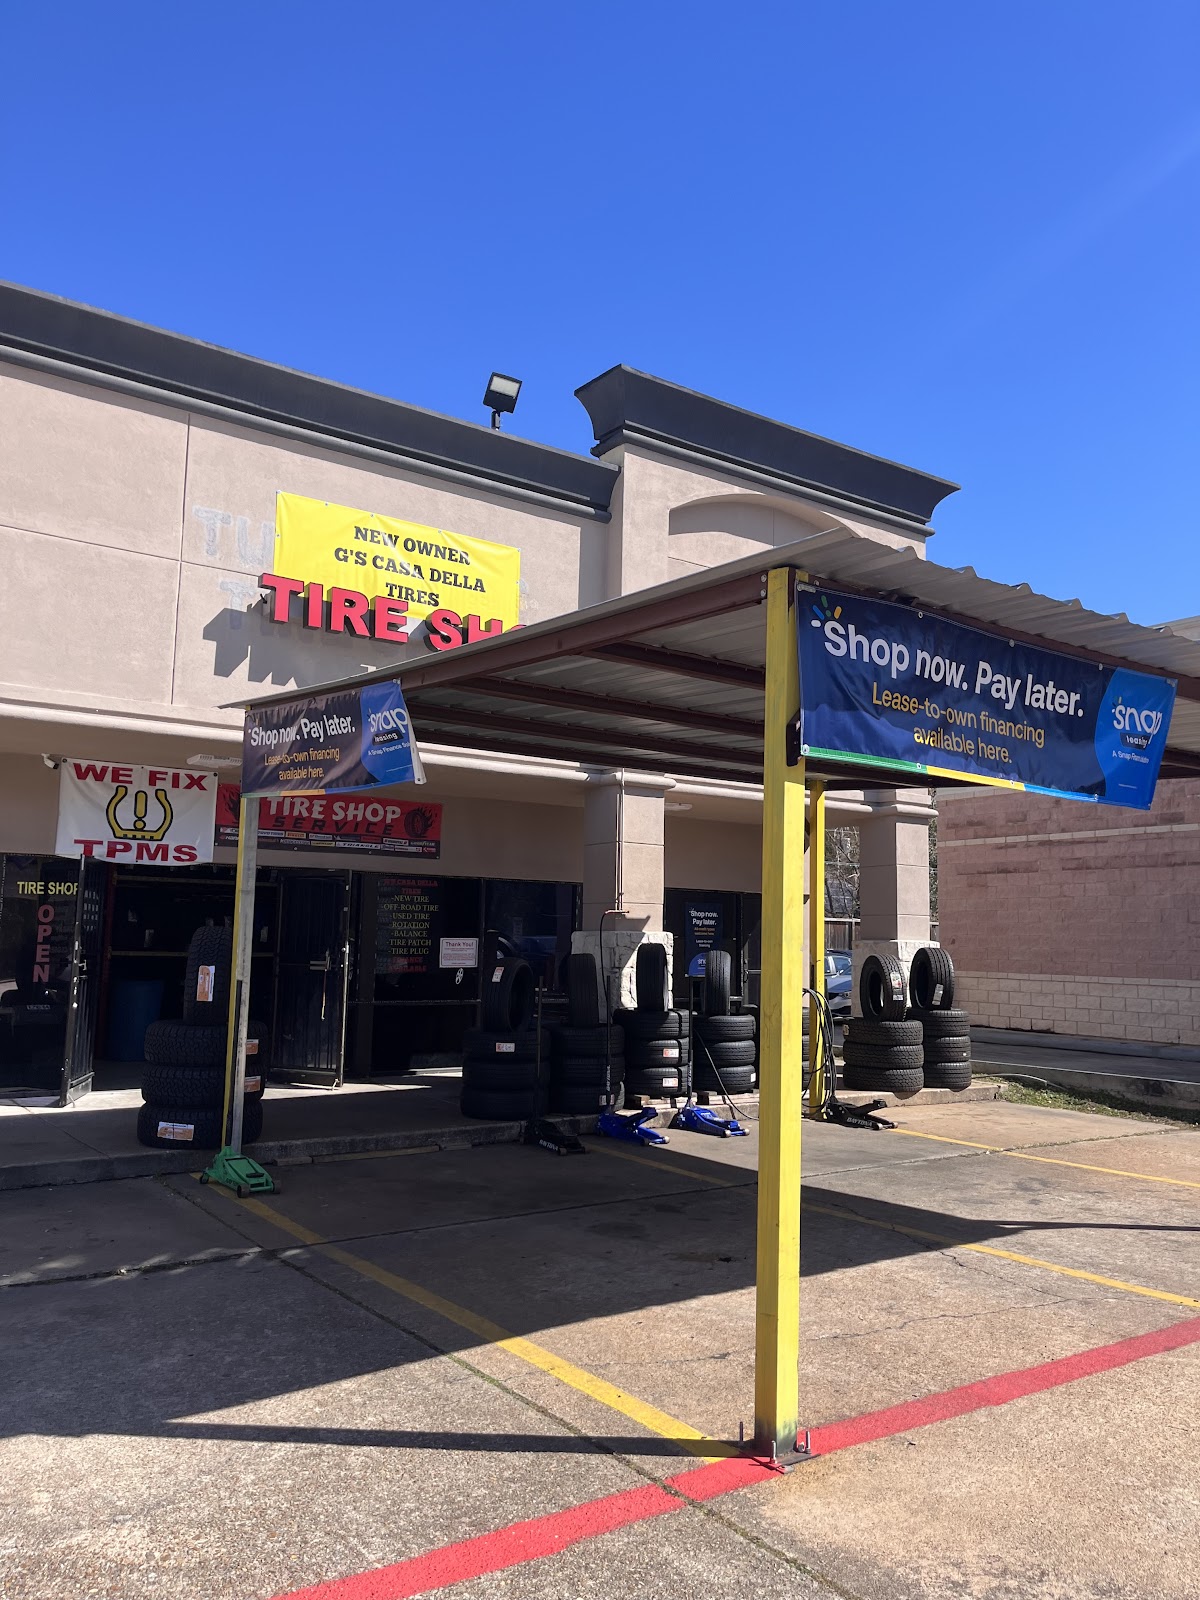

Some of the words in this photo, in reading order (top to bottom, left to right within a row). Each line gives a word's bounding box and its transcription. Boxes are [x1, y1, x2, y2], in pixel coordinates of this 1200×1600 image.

[354, 525, 399, 549] NEW
[404, 537, 470, 565] OWNER
[334, 547, 367, 566] G'S
[372, 555, 424, 579] CASA
[429, 567, 486, 593] DELLA
[385, 582, 440, 607] TIRES
[258, 573, 409, 643] TIRE
[425, 608, 527, 651] SH
[823, 620, 910, 678] Shop
[915, 647, 968, 691] now.
[975, 660, 1022, 710] Pay
[1025, 674, 1084, 718] later.
[370, 707, 408, 733] snap
[872, 682, 977, 728] Lease-to-own
[980, 711, 1045, 748] financing
[251, 726, 279, 749] Shop
[279, 726, 300, 743] now.
[300, 718, 324, 742] Pay
[324, 714, 356, 736] later.
[914, 726, 975, 756] available
[978, 737, 1013, 764] here.
[264, 750, 309, 766] Lease-to-own
[309, 746, 340, 763] financing
[73, 763, 133, 785] WE
[148, 769, 208, 791] FIX
[278, 767, 307, 780] available
[308, 765, 324, 779] here.
[267, 796, 327, 819] TIRE
[332, 801, 401, 824] SHOP
[272, 816, 394, 836] SERVICE
[74, 839, 198, 863] TPMS
[17, 882, 44, 895] TIRE
[690, 910, 705, 918] Shop
[32, 904, 55, 983] OPEN
